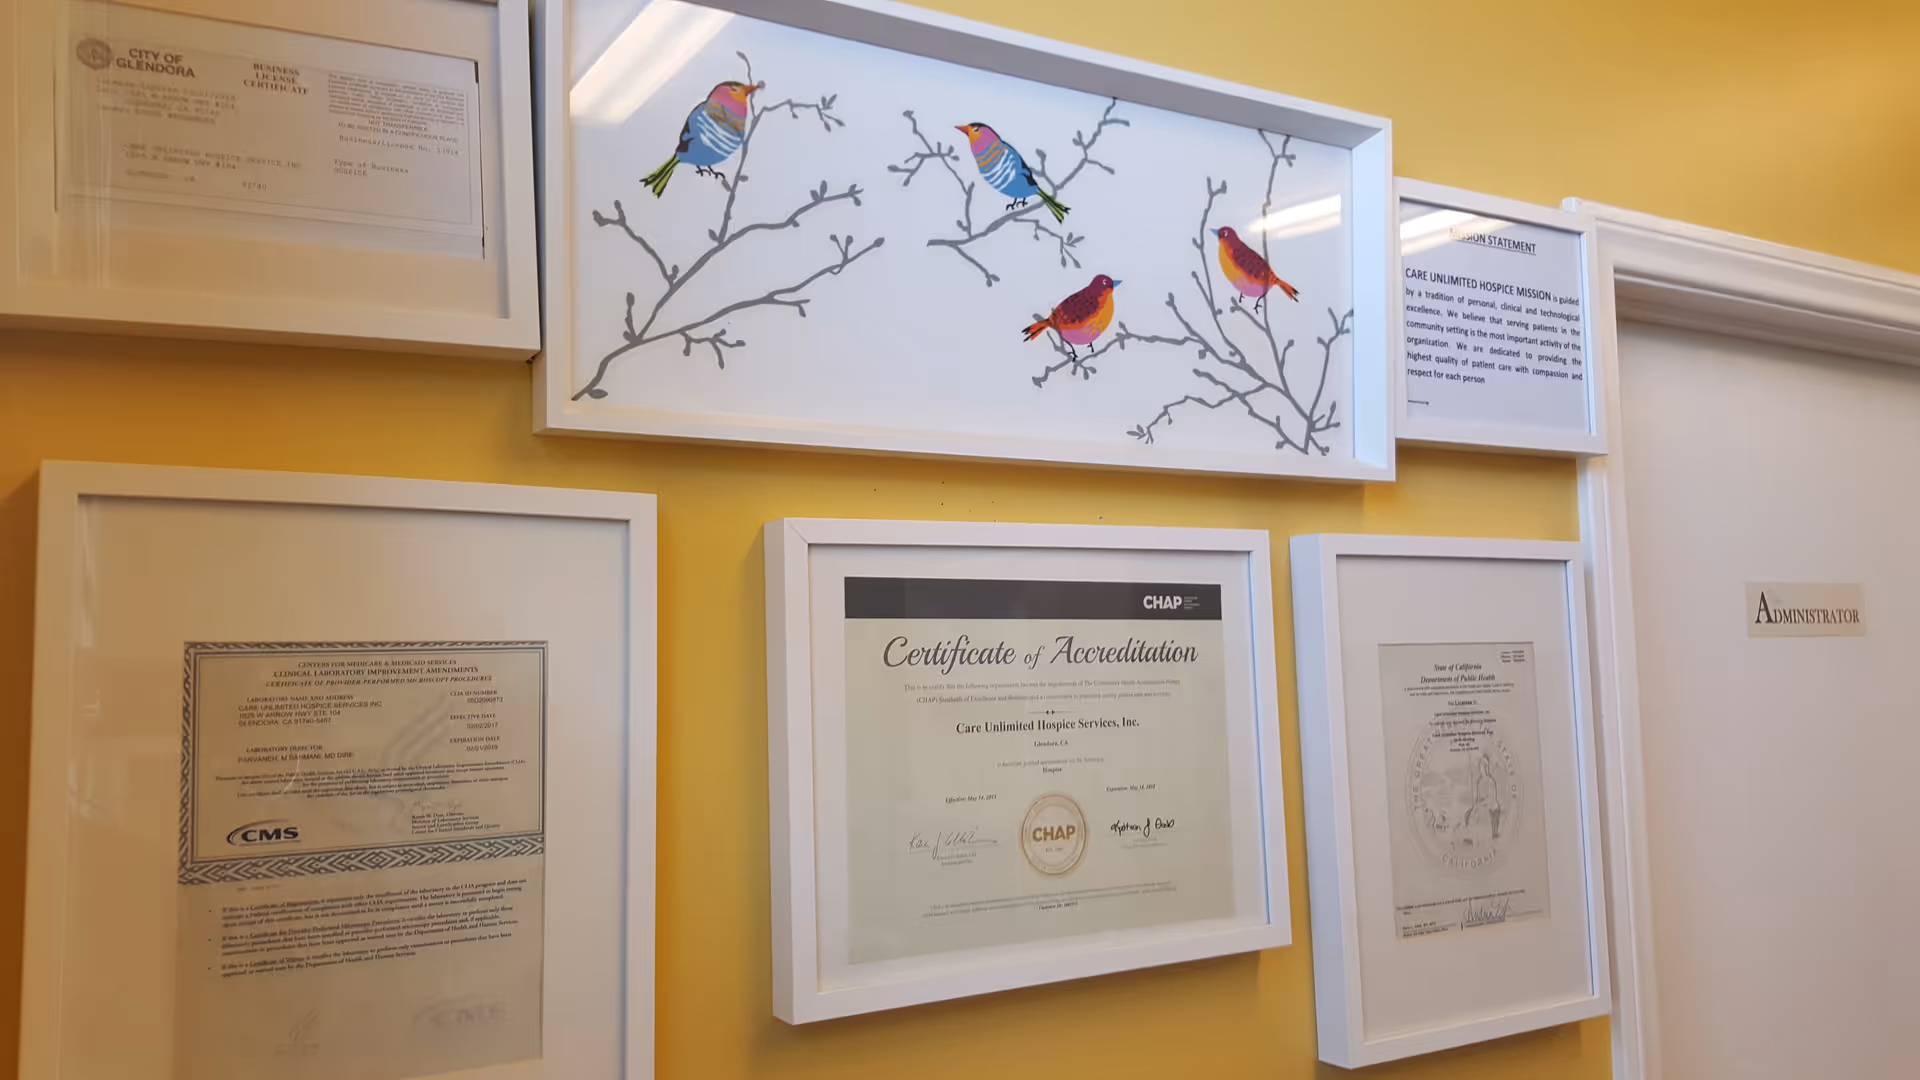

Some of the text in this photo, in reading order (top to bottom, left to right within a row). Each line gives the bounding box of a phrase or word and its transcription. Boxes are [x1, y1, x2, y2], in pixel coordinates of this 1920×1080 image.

[129, 48, 183, 64] CITY OF
[116, 58, 195, 78] GLENDORA
[253, 63, 300, 76] BUSINESS
[255, 72, 296, 84] LICENSE
[243, 79, 308, 95] CERTIFICATE
[1488, 236, 1536, 253] STATEMENT
[1406, 268, 1428, 280] CARE
[1430, 272, 1477, 289] UNLIMITED
[1480, 282, 1514, 295] HOSPICE
[1517, 287, 1551, 301] MISSION
[1559, 297, 1579, 306] guided
[1406, 287, 1414, 297] by
[1425, 290, 1454, 302] tradition
[1458, 296, 1464, 304] of
[1468, 298, 1497, 310] personal,
[1500, 302, 1522, 312] clinical
[1526, 307, 1537, 315] and
[1540, 309, 1580, 322] technological
[1406, 305, 1580, 337] excellence. We believe that serving patients in the
[1406, 320, 1581, 351] community setting is the most important activity of the
[1456, 342, 1467, 351] We
[1489, 347, 1520, 358] dedicated
[1526, 351, 1532, 359] to
[1538, 353, 1567, 365] providing
[1572, 357, 1582, 366] the
[1407, 352, 1582, 381] highest quality of patient care with compassion and
[1408, 368, 1485, 384] respect for each person
[1143, 595, 1182, 610] CHAP
[883, 635, 1198, 675] Certificate of Accreditation
[274, 666, 478, 678] CLINICAL LABORATORY IMPROVEMENT AMENDMENTS
[1455, 663, 1482, 671] California
[1454, 675, 1459, 683] of
[1460, 674, 1477, 682] Public
[1478, 673, 1495, 682] Health
[238, 704, 258, 712] CARE
[260, 703, 299, 711] UNLIMITED
[301, 702, 331, 710] HOSPICE
[956, 717, 1139, 734] Care Unlimited Hospice Services, Inc.
[241, 827, 298, 843] CMS
[1032, 825, 1076, 842] CHAP
